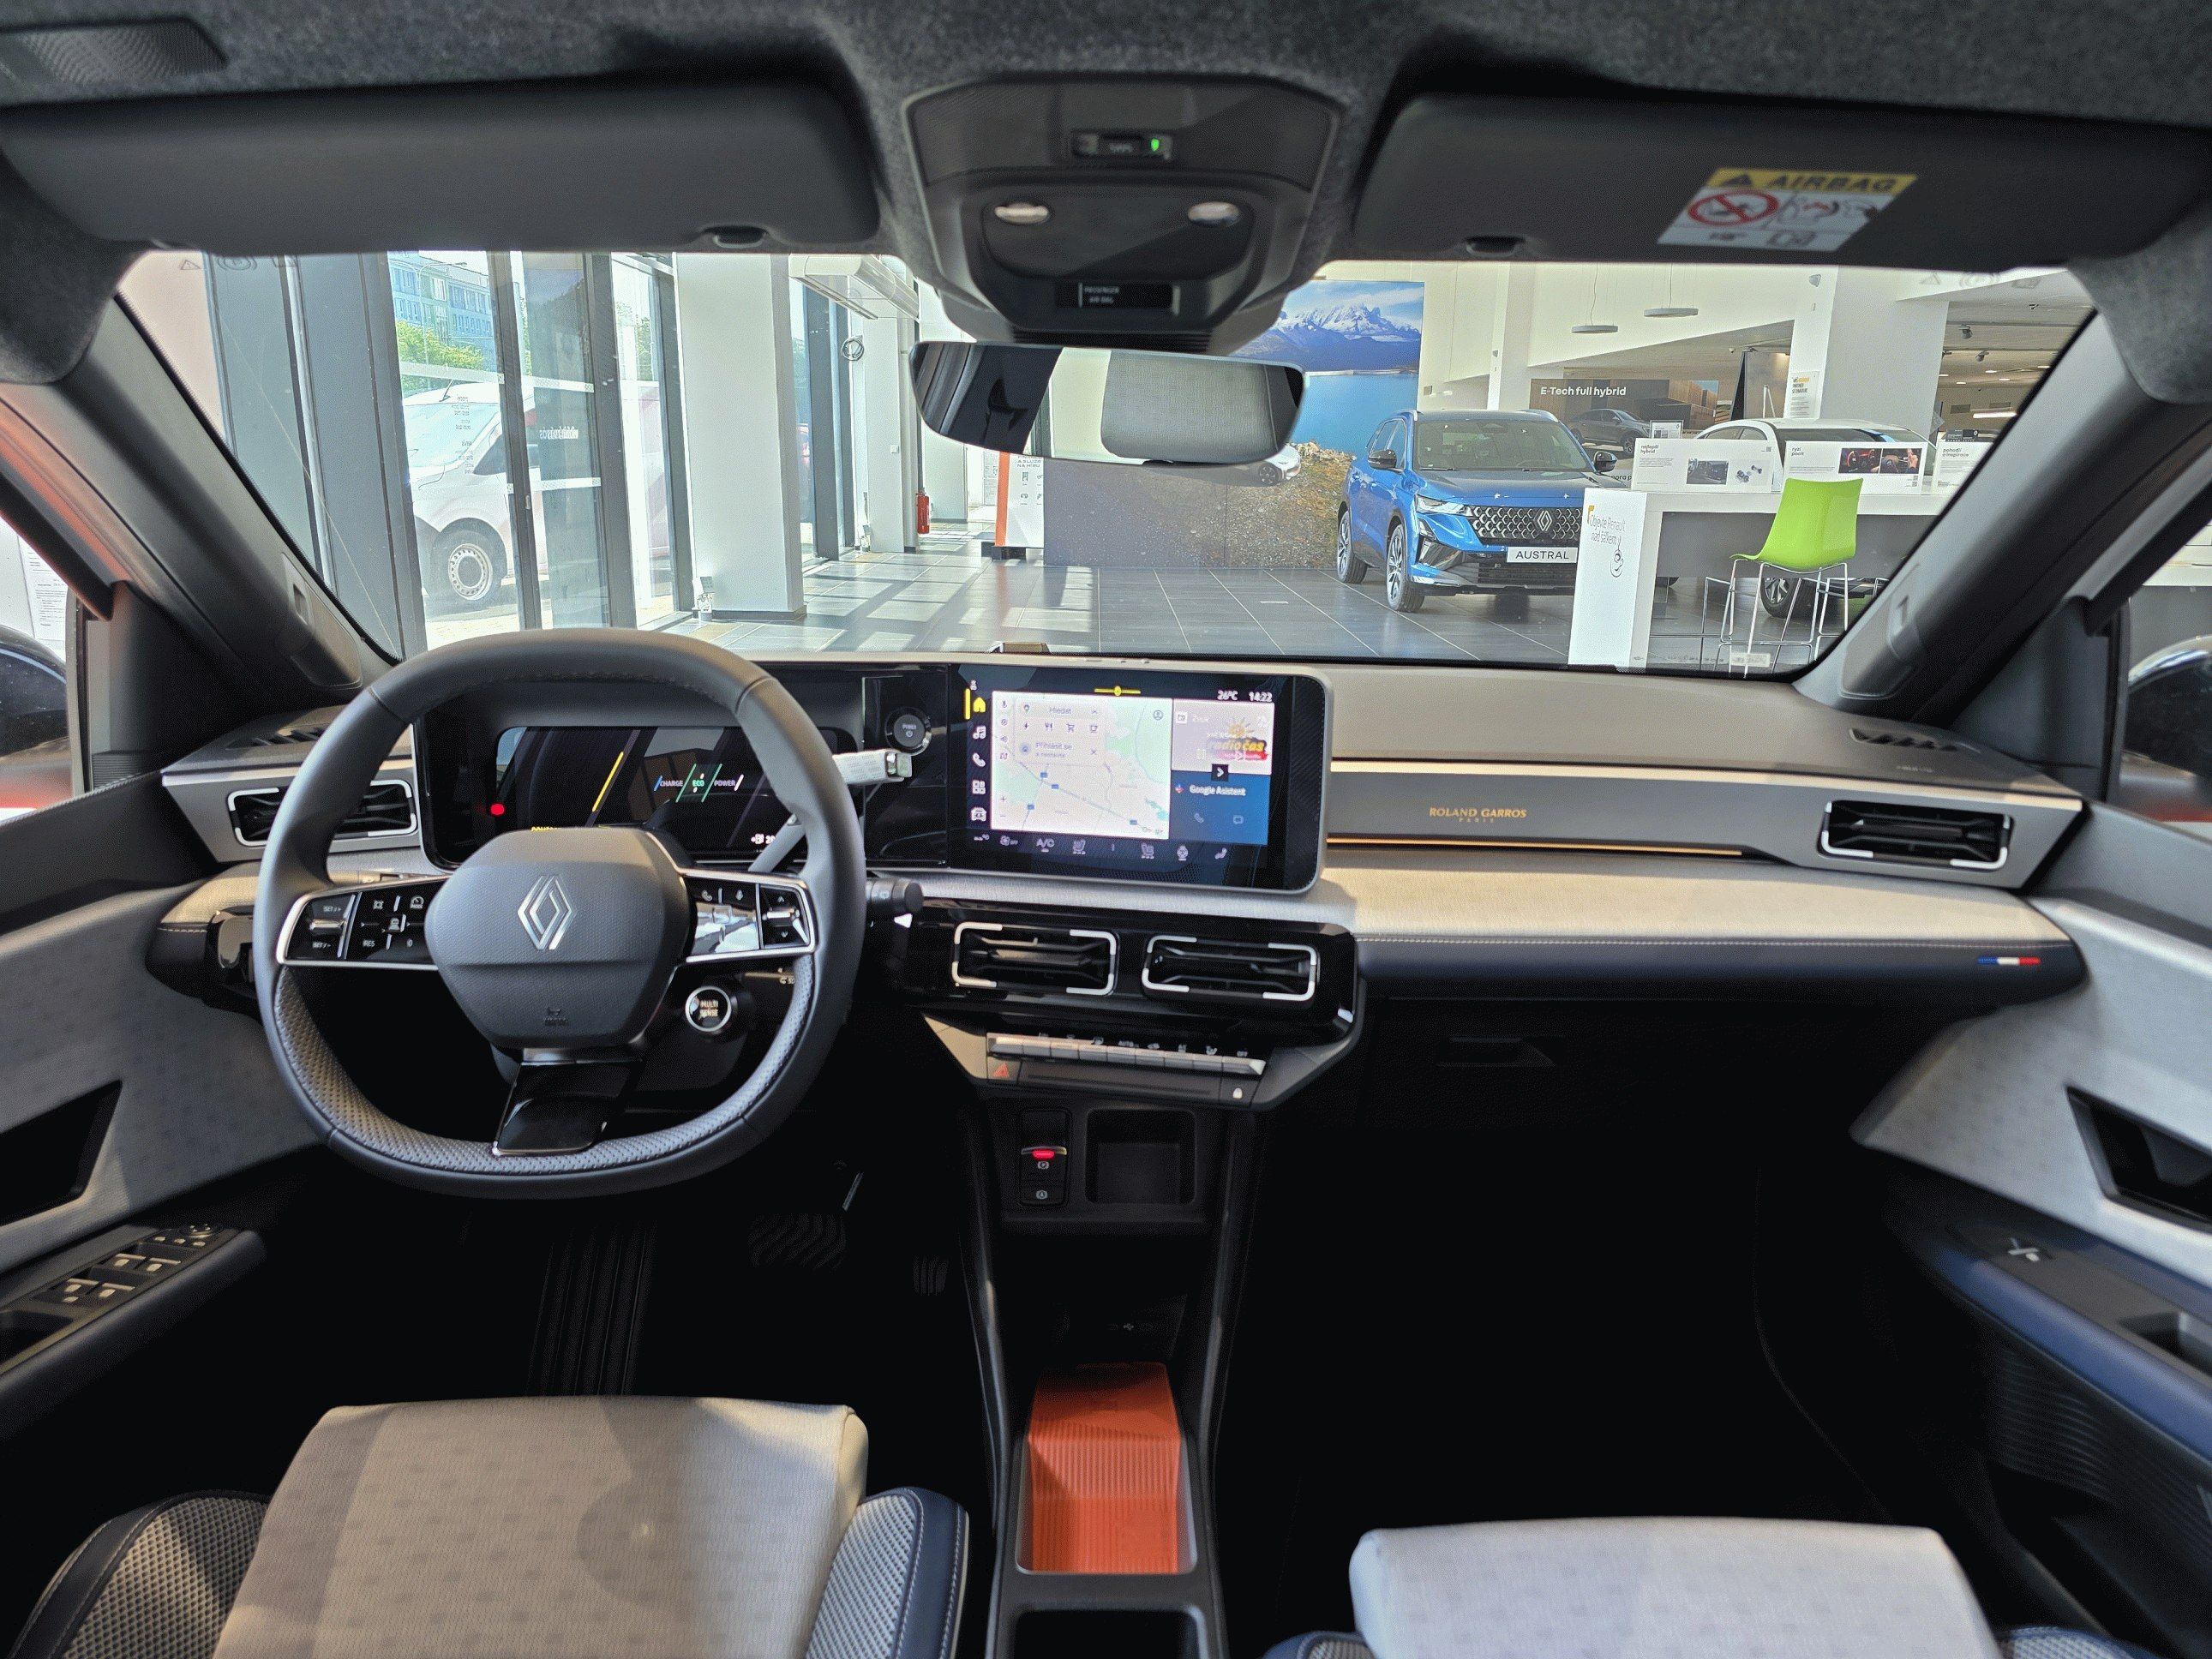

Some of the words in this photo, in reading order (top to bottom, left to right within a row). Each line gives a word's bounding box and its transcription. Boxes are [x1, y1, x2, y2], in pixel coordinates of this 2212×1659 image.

[1766, 175, 1897, 193] AIRBAG
[1540, 386, 1574, 395] E-Tech
[1575, 386, 1592, 395] full
[1593, 386, 1626, 397] hybrid
[1515, 550, 1570, 560] AUSTRAL
[1189, 785, 1215, 796] Google
[1429, 807, 1478, 817] ROLAND
[1480, 808, 1527, 818] GARROS
[1035, 838, 1055, 847] A/C
[699, 999, 719, 1008] MULTI
